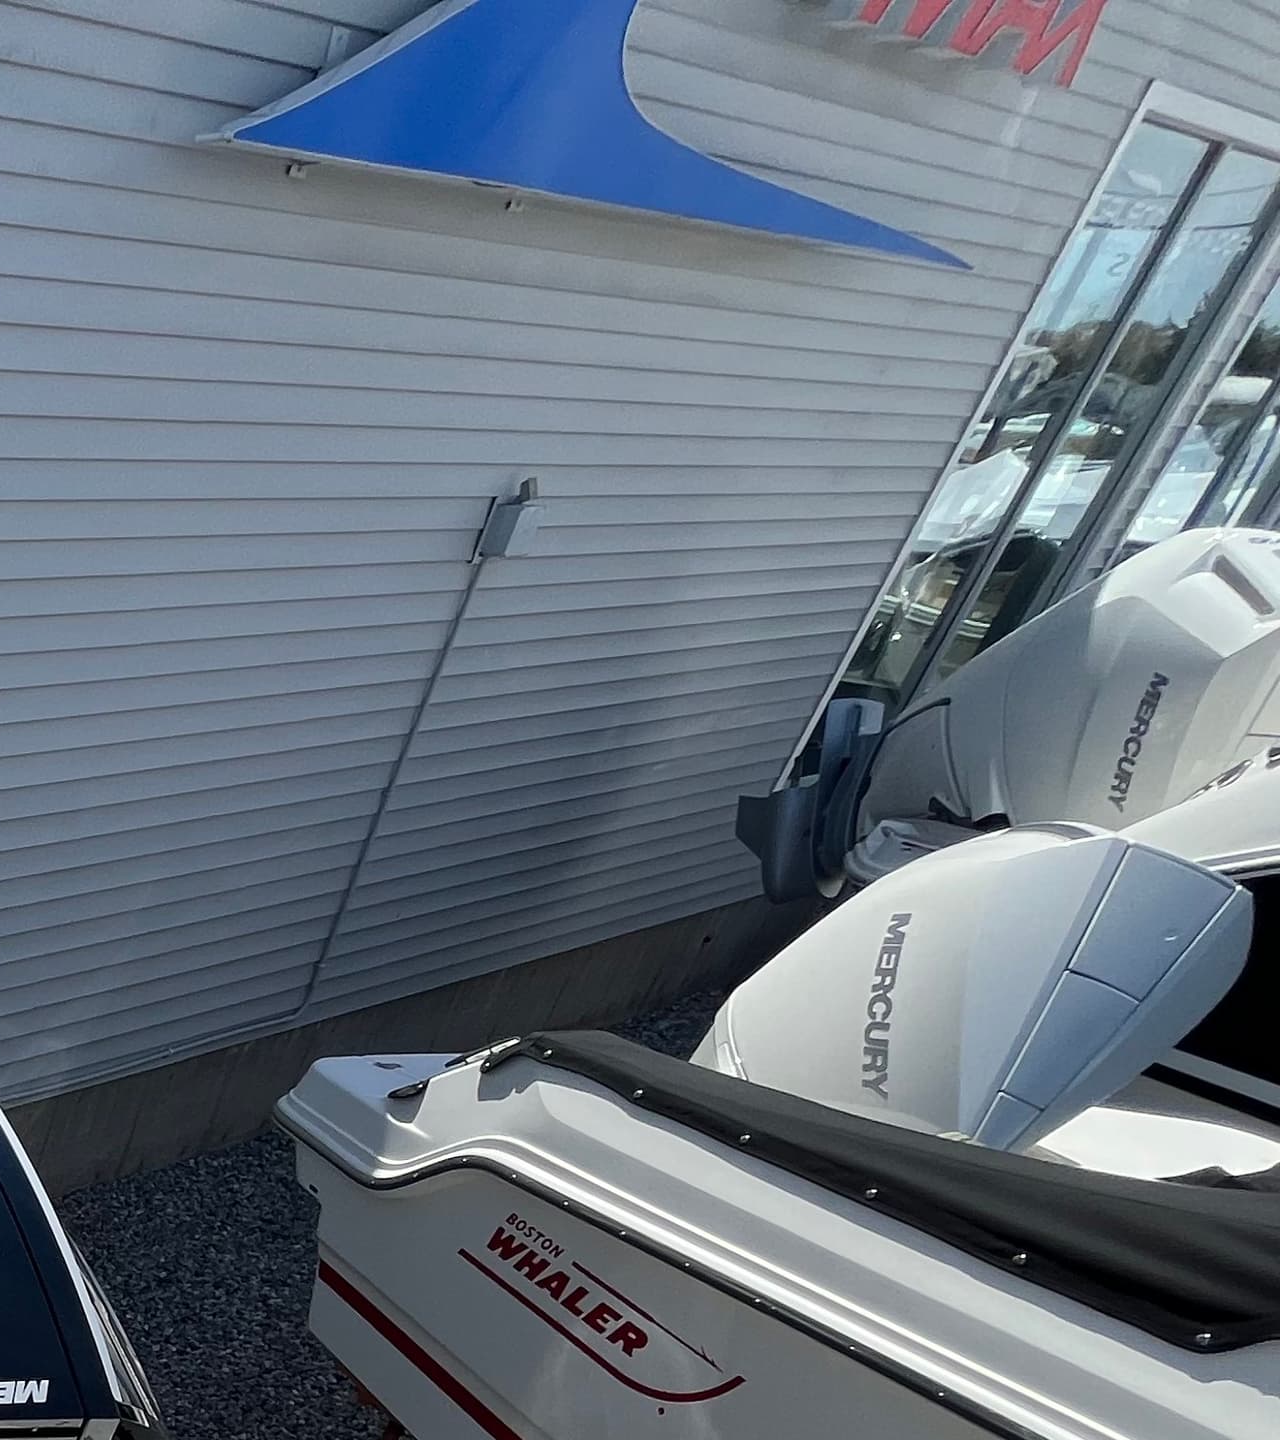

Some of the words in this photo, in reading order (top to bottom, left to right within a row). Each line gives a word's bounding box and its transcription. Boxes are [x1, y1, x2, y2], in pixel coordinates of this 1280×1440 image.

[1108, 671, 1171, 813] MERCURY
[860, 912, 913, 1101] MERCURY
[486, 1226, 649, 1358] WHALER
[505, 1212, 565, 1259] BOSTON
